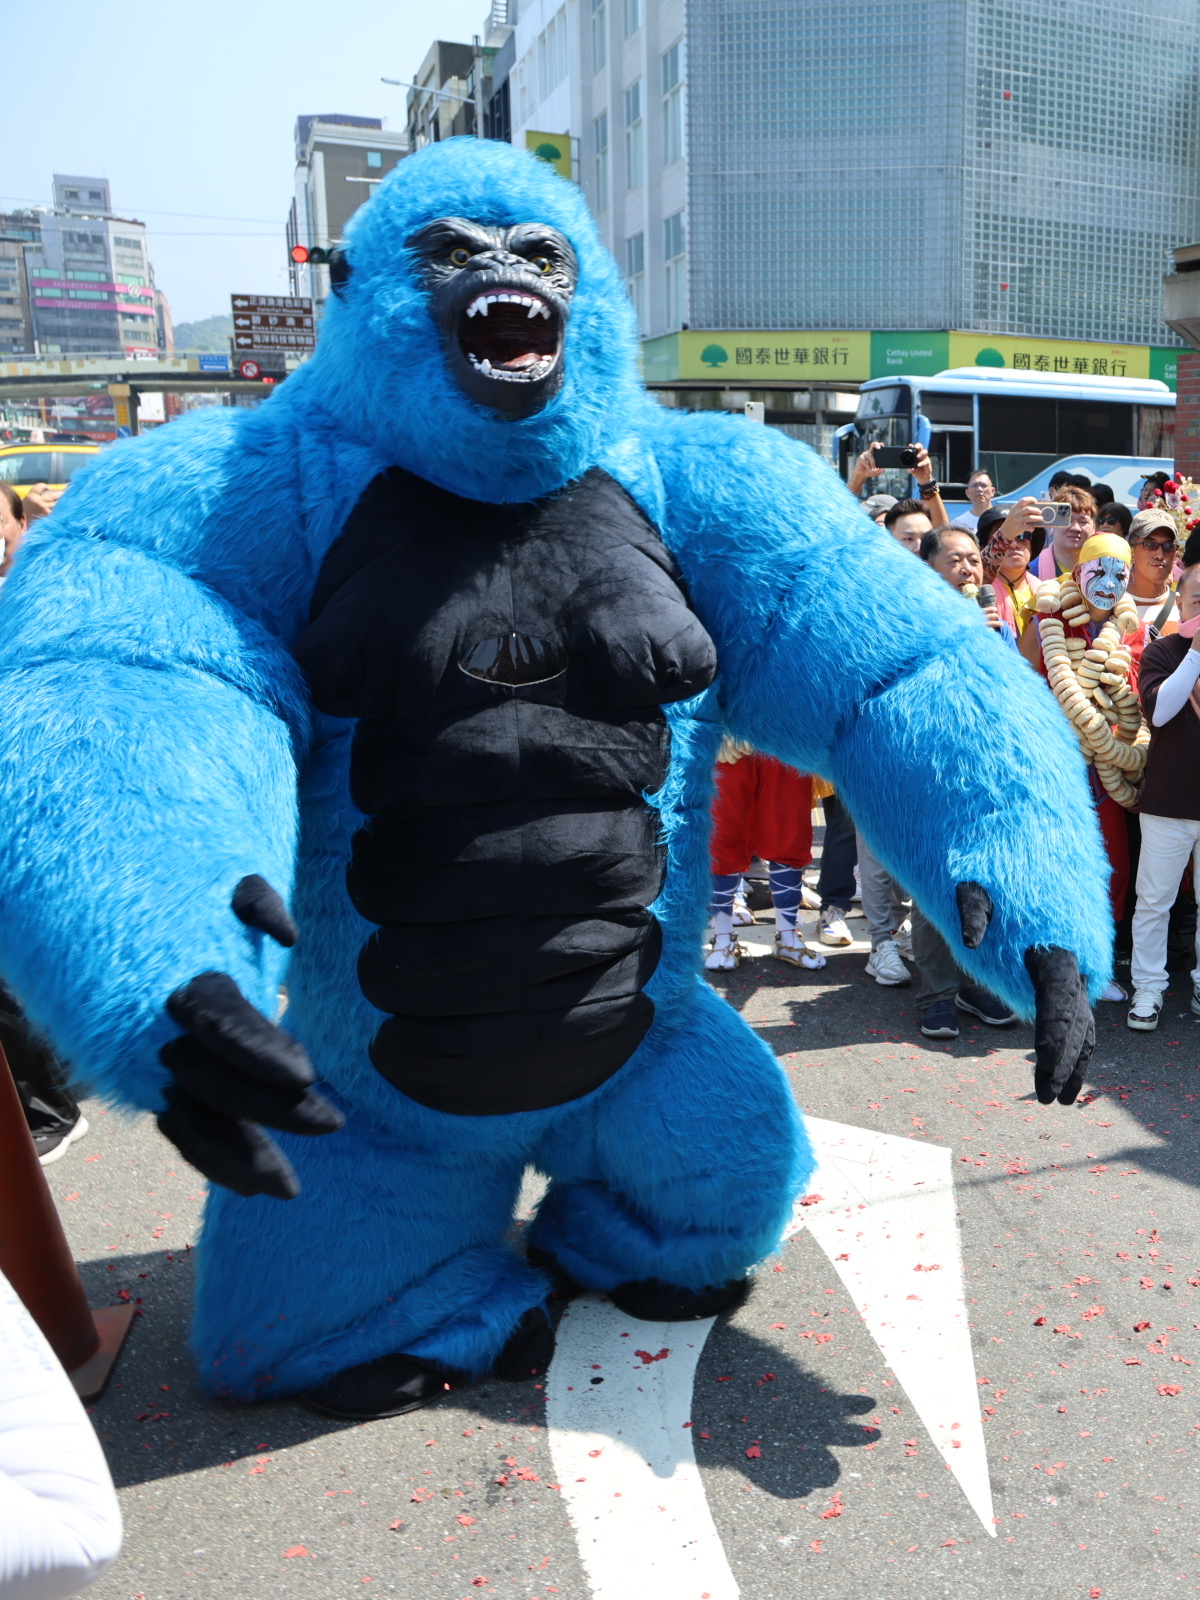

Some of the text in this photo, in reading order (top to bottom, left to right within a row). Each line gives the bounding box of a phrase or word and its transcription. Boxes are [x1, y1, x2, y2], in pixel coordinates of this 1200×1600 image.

[735, 346, 849, 366] 國泰世華銀行
[886, 349, 933, 358] Cathay United
[886, 357, 904, 365] Bank
[1013, 353, 1127, 377] 國泰世華銀行
